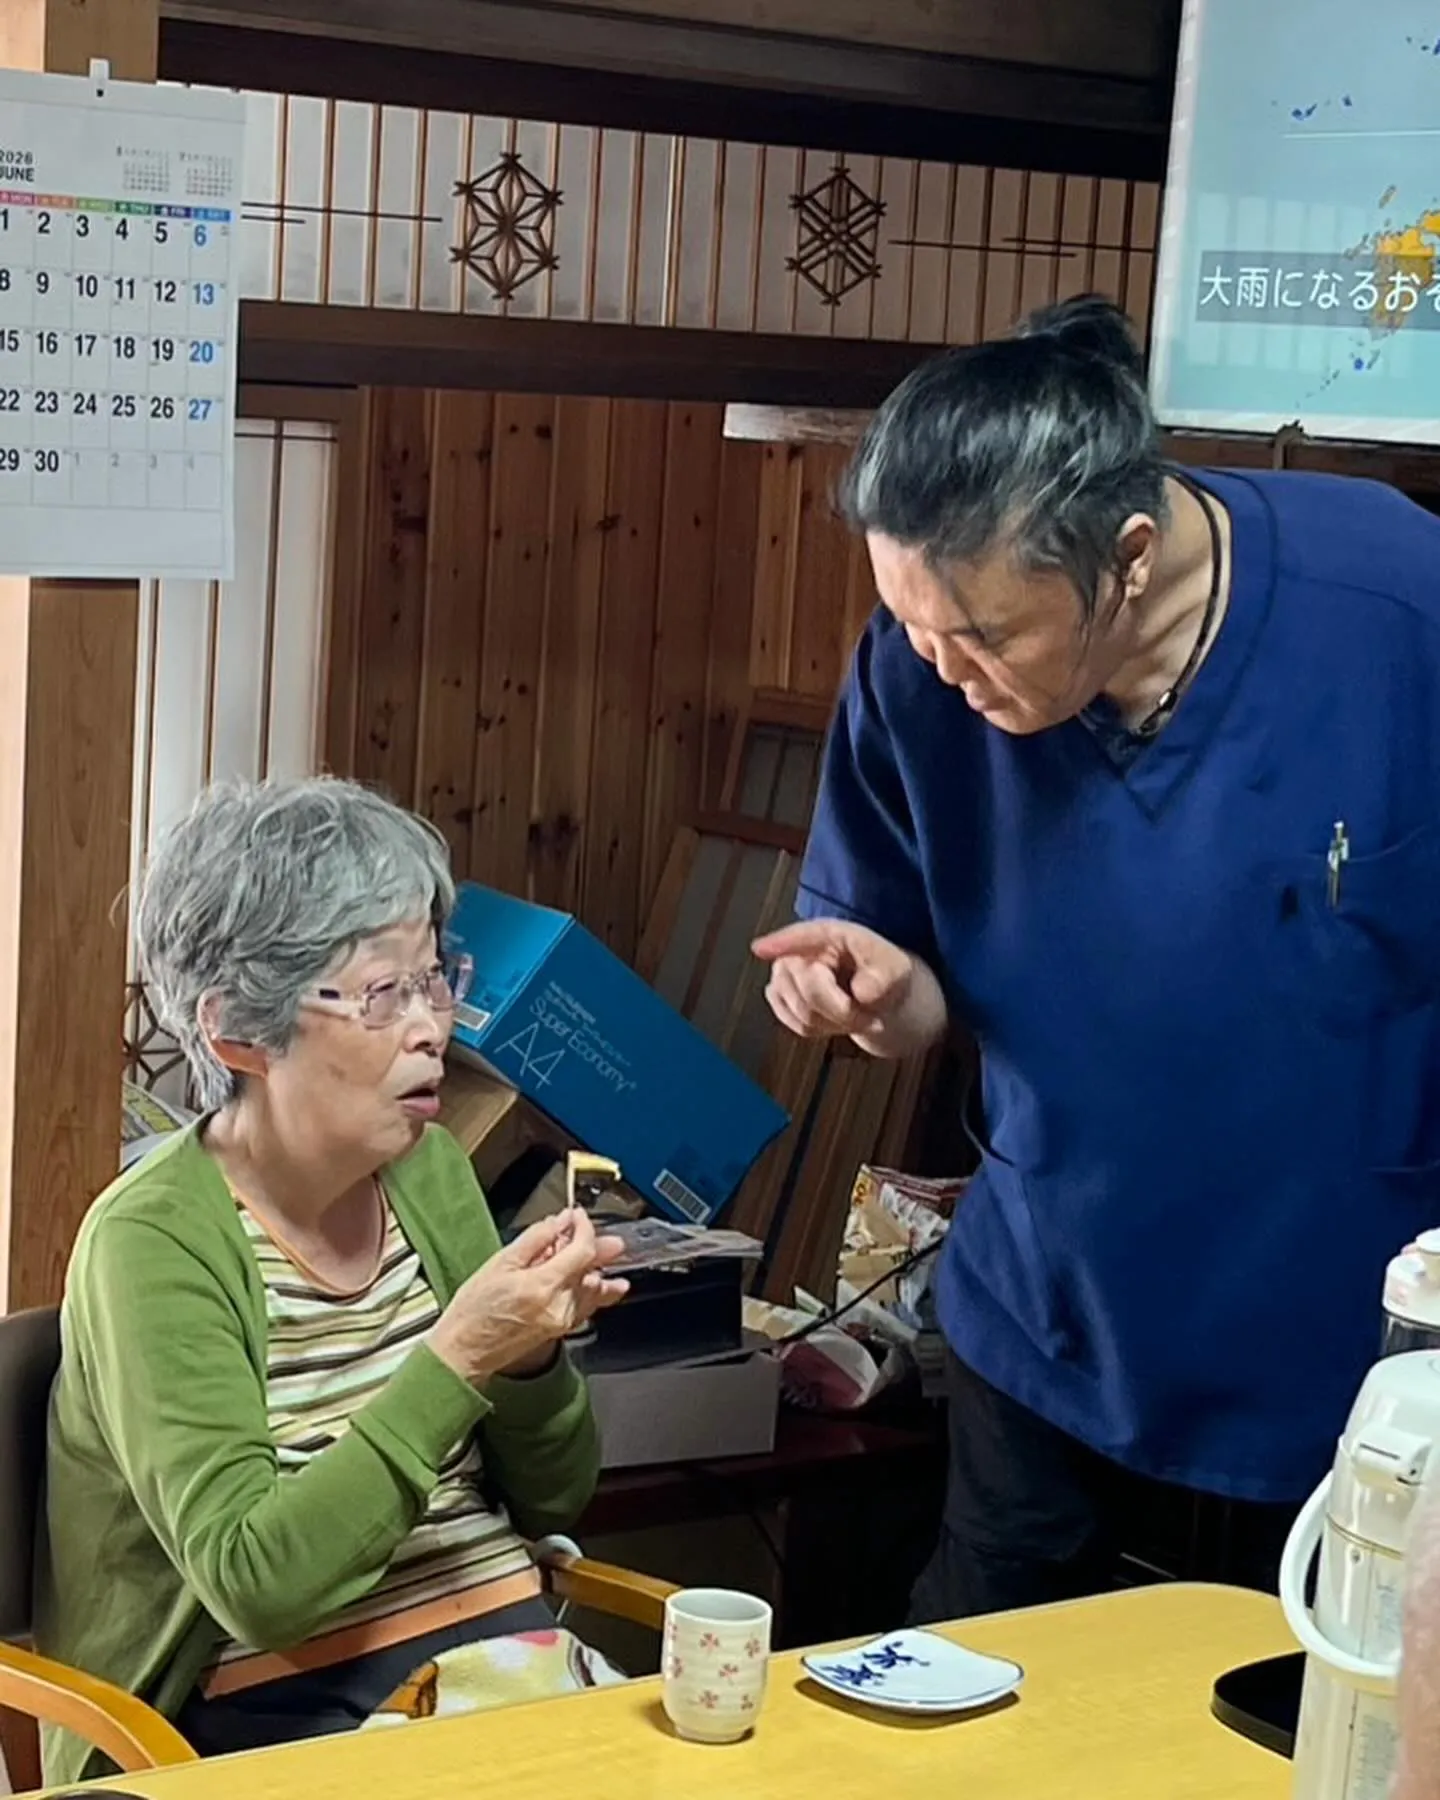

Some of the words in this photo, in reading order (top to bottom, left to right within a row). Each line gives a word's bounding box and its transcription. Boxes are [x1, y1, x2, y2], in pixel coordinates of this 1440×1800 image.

[0, 208, 8, 231] 1
[38, 211, 51, 234] 2
[76, 214, 89, 237] 3
[116, 218, 128, 240] 4
[154, 221, 168, 244] 5
[194, 225, 206, 247] 6
[0, 268, 10, 291] 8
[36, 271, 49, 294] 9
[75, 274, 98, 298] 10
[115, 277, 135, 300] 11
[154, 280, 176, 303] 12
[193, 283, 214, 305] 13
[0, 328, 19, 352] 15
[36, 331, 58, 354] 16
[75, 333, 97, 356] 17
[114, 336, 135, 359] 18
[152, 338, 174, 361] 19
[189, 340, 213, 363] 20
[0, 388, 20, 411] 22
[35, 390, 58, 413] 23
[74, 392, 97, 415] 24
[112, 394, 136, 417] 25
[150, 396, 174, 419] 26
[188, 398, 212, 420] 27
[0, 447, 20, 471] 29
[35, 449, 59, 472] 30
[111, 452, 120, 468] 2
[493, 1021, 565, 1090] A4
